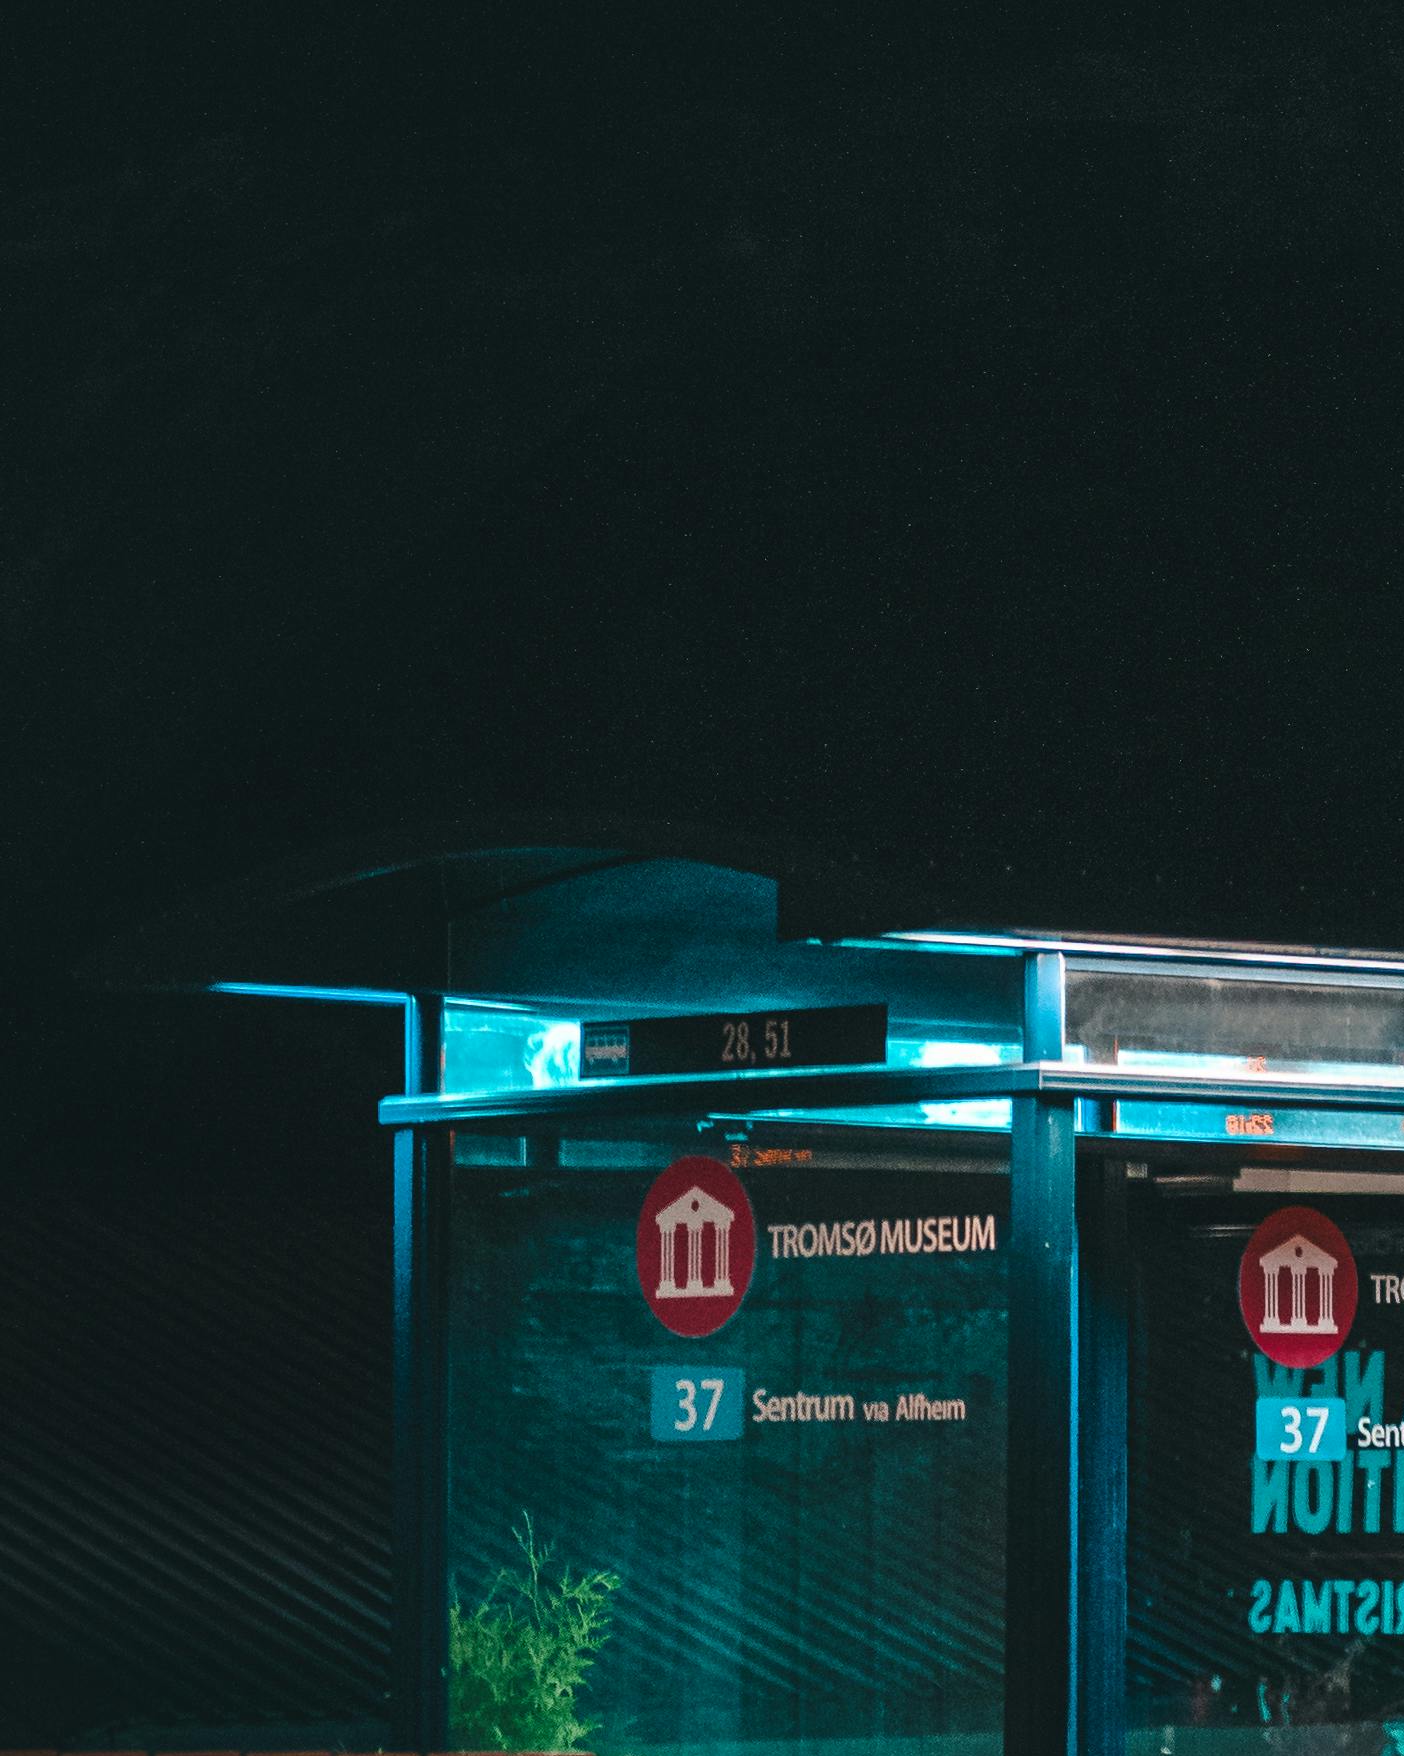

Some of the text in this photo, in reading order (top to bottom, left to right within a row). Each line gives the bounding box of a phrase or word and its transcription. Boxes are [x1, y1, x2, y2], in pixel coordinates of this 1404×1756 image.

[764, 1018, 793, 1059] 51
[767, 1214, 996, 1258] TROMSØ MUSEUM
[674, 1377, 966, 1432] 37 Sentrum via Alfheim
[1280, 1405, 1329, 1454] 37
